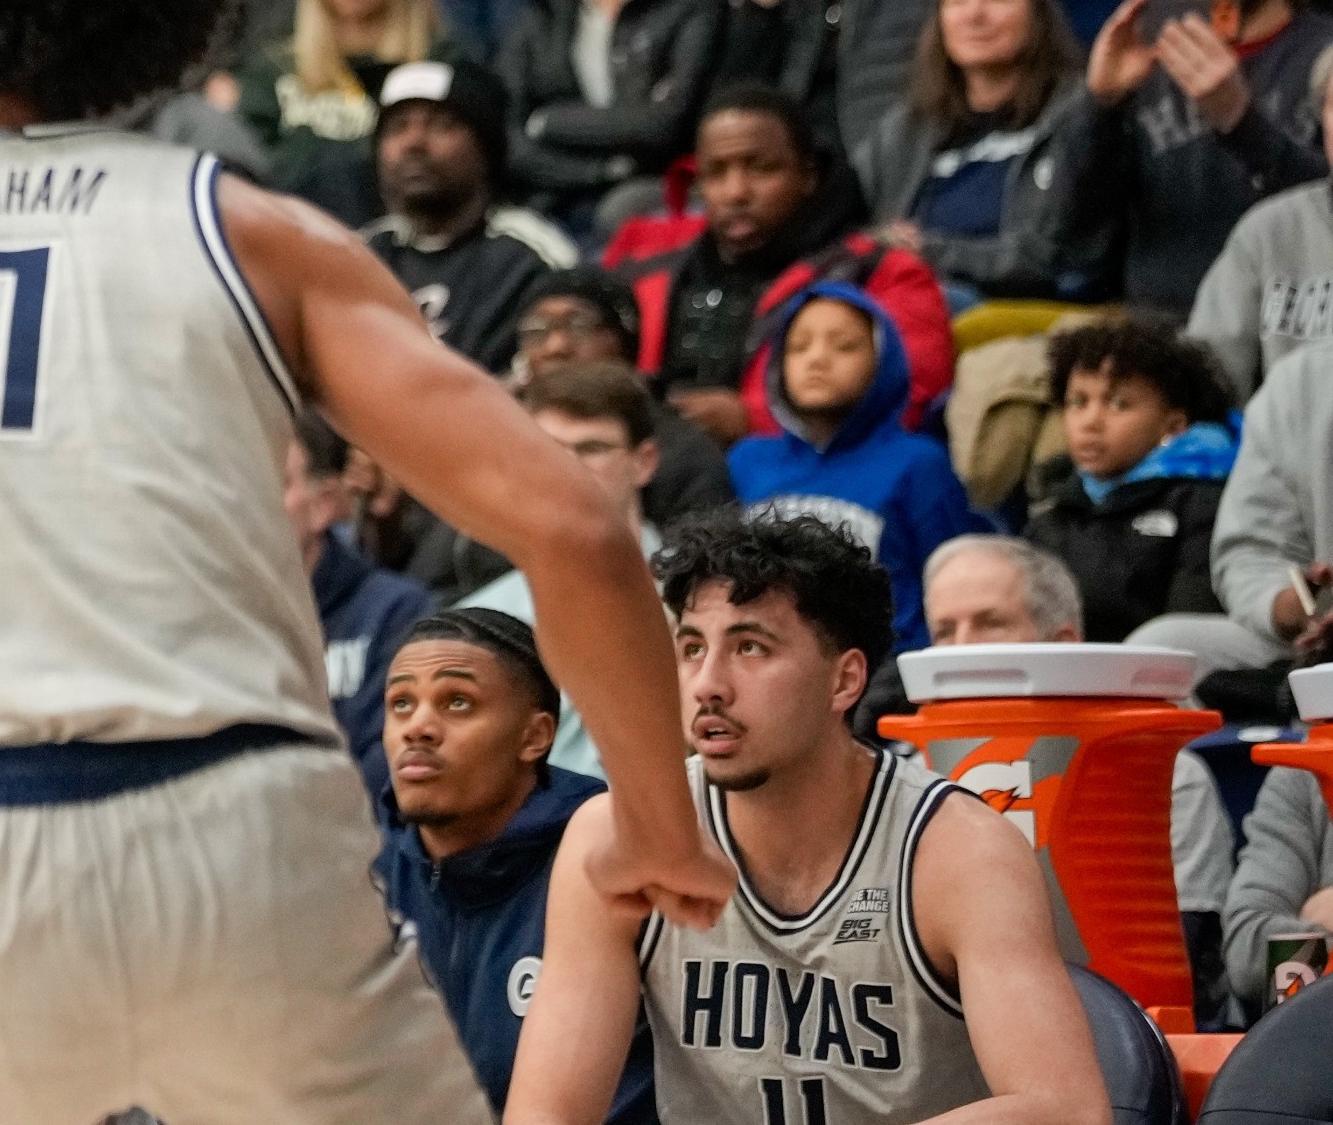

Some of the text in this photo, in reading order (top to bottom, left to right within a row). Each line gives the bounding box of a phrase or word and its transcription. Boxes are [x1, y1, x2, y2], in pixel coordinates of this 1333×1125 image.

[865, 888, 888, 901] THE
[847, 900, 889, 914] CHANGE
[840, 918, 872, 930] BIG
[835, 928, 881, 940] EAST
[682, 959, 902, 1072] HOYAS
